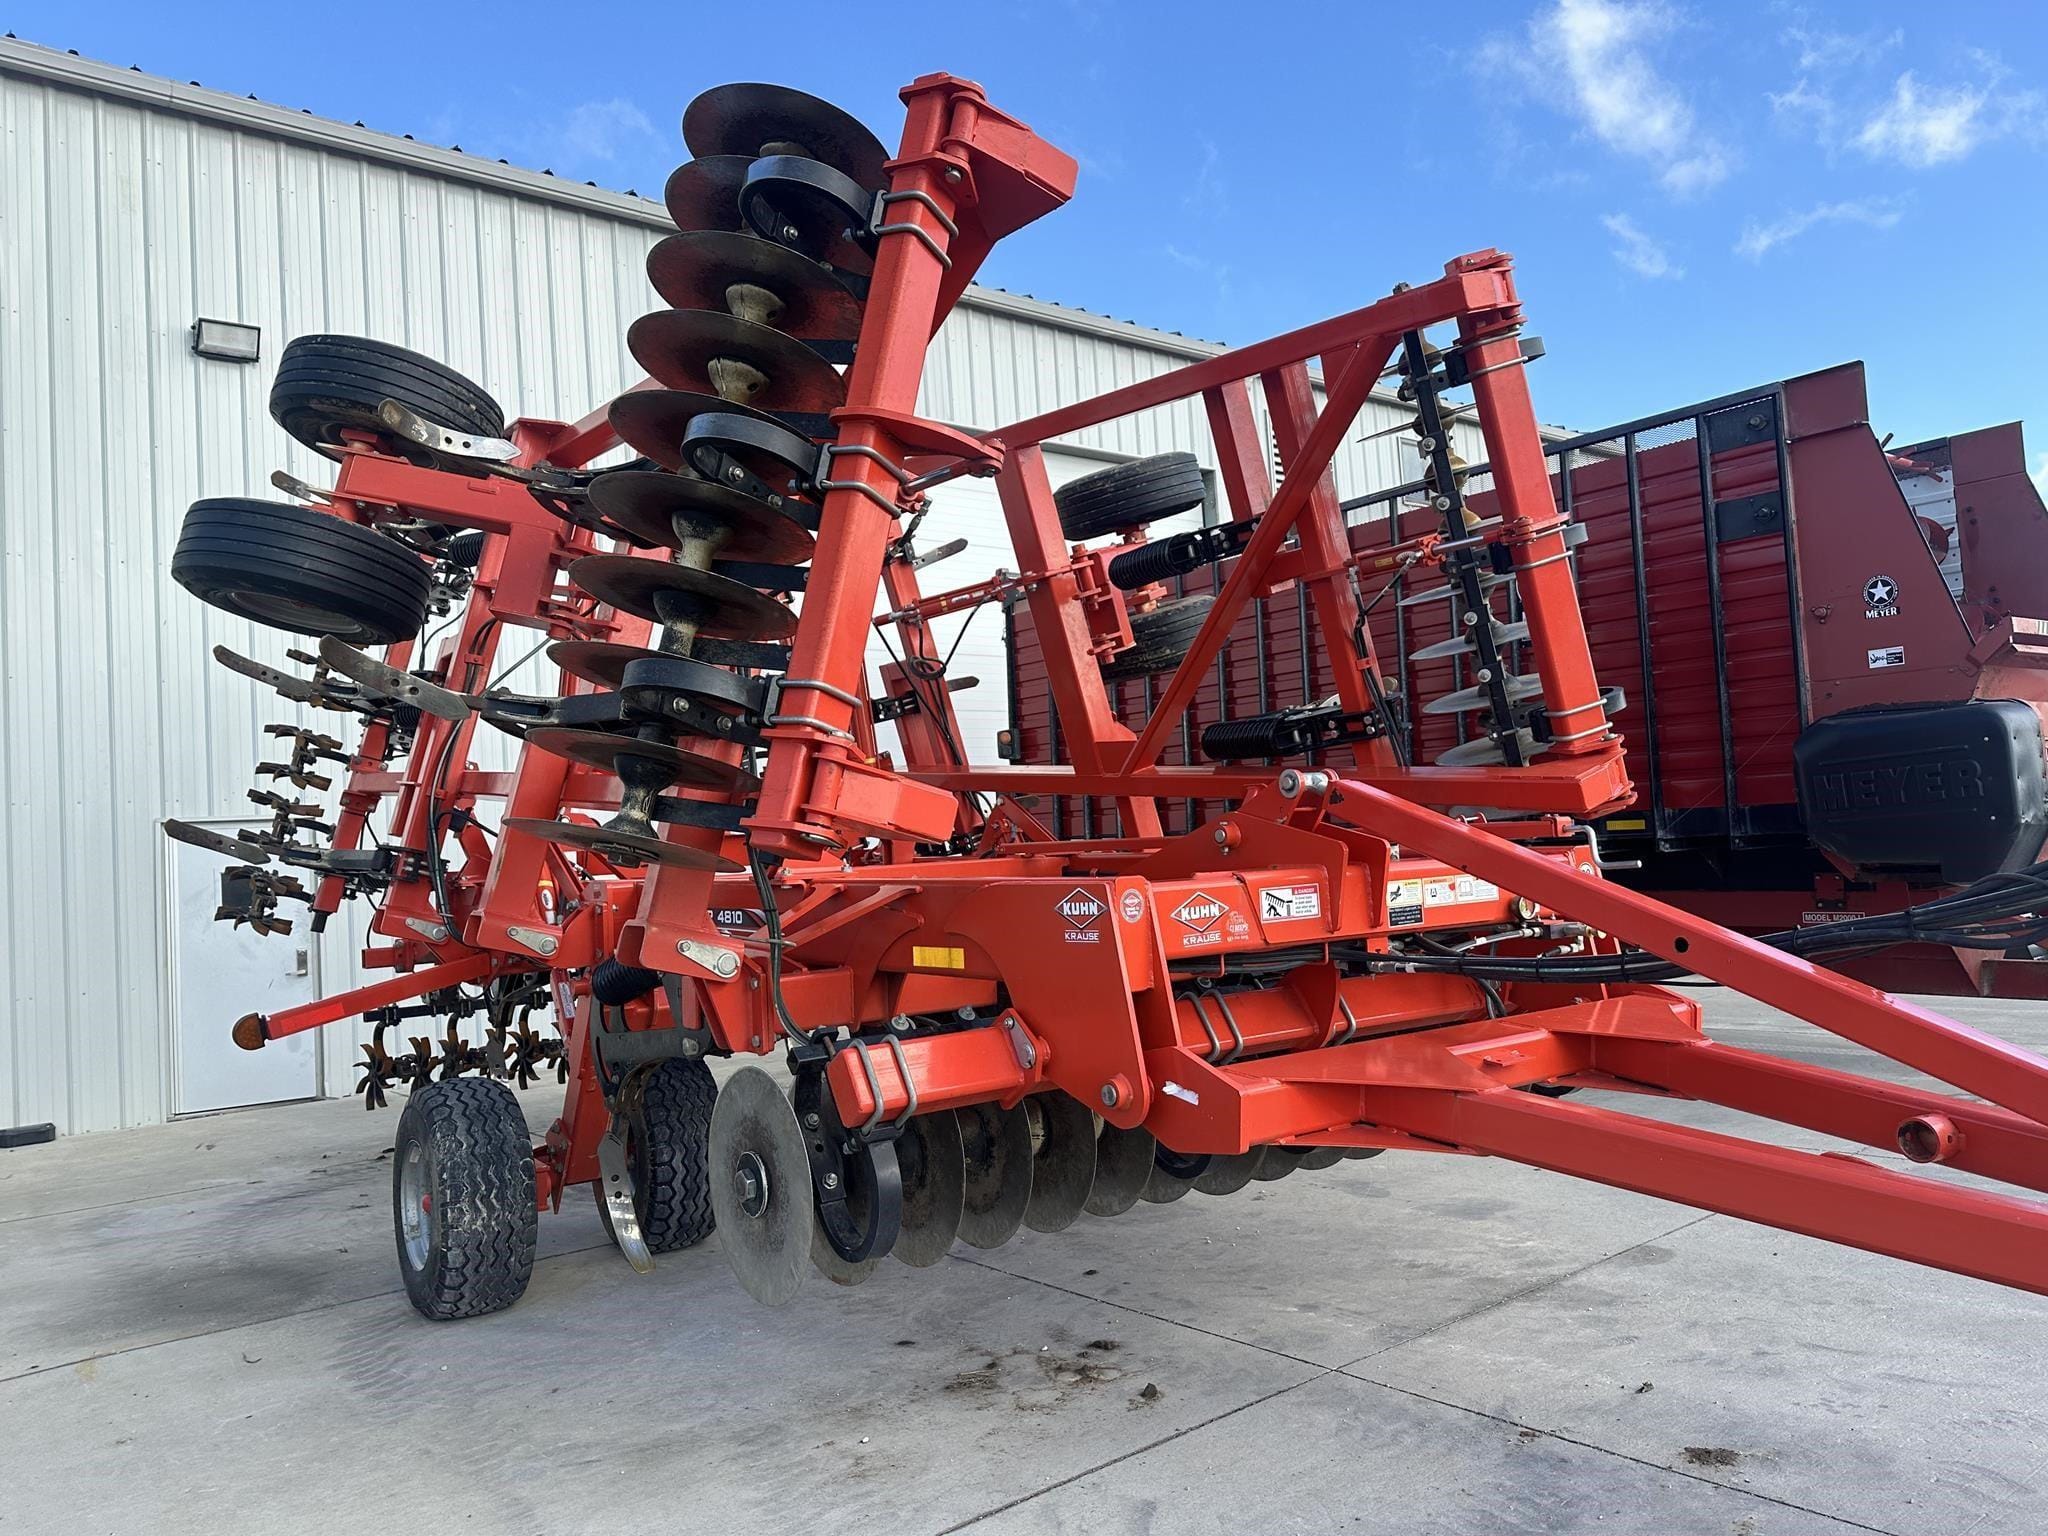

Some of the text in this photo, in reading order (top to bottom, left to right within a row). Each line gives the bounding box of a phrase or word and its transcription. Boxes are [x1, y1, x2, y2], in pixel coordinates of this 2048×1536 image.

[1865, 607, 1898, 619] MEYER
[1812, 759, 1985, 811] MEYER
[1063, 902, 1098, 915] KUHN
[1181, 903, 1220, 921] KUHN
[717, 910, 743, 924] 4810
[1065, 932, 1099, 941] KRAUSE
[1183, 933, 1221, 945] KRAUSE
